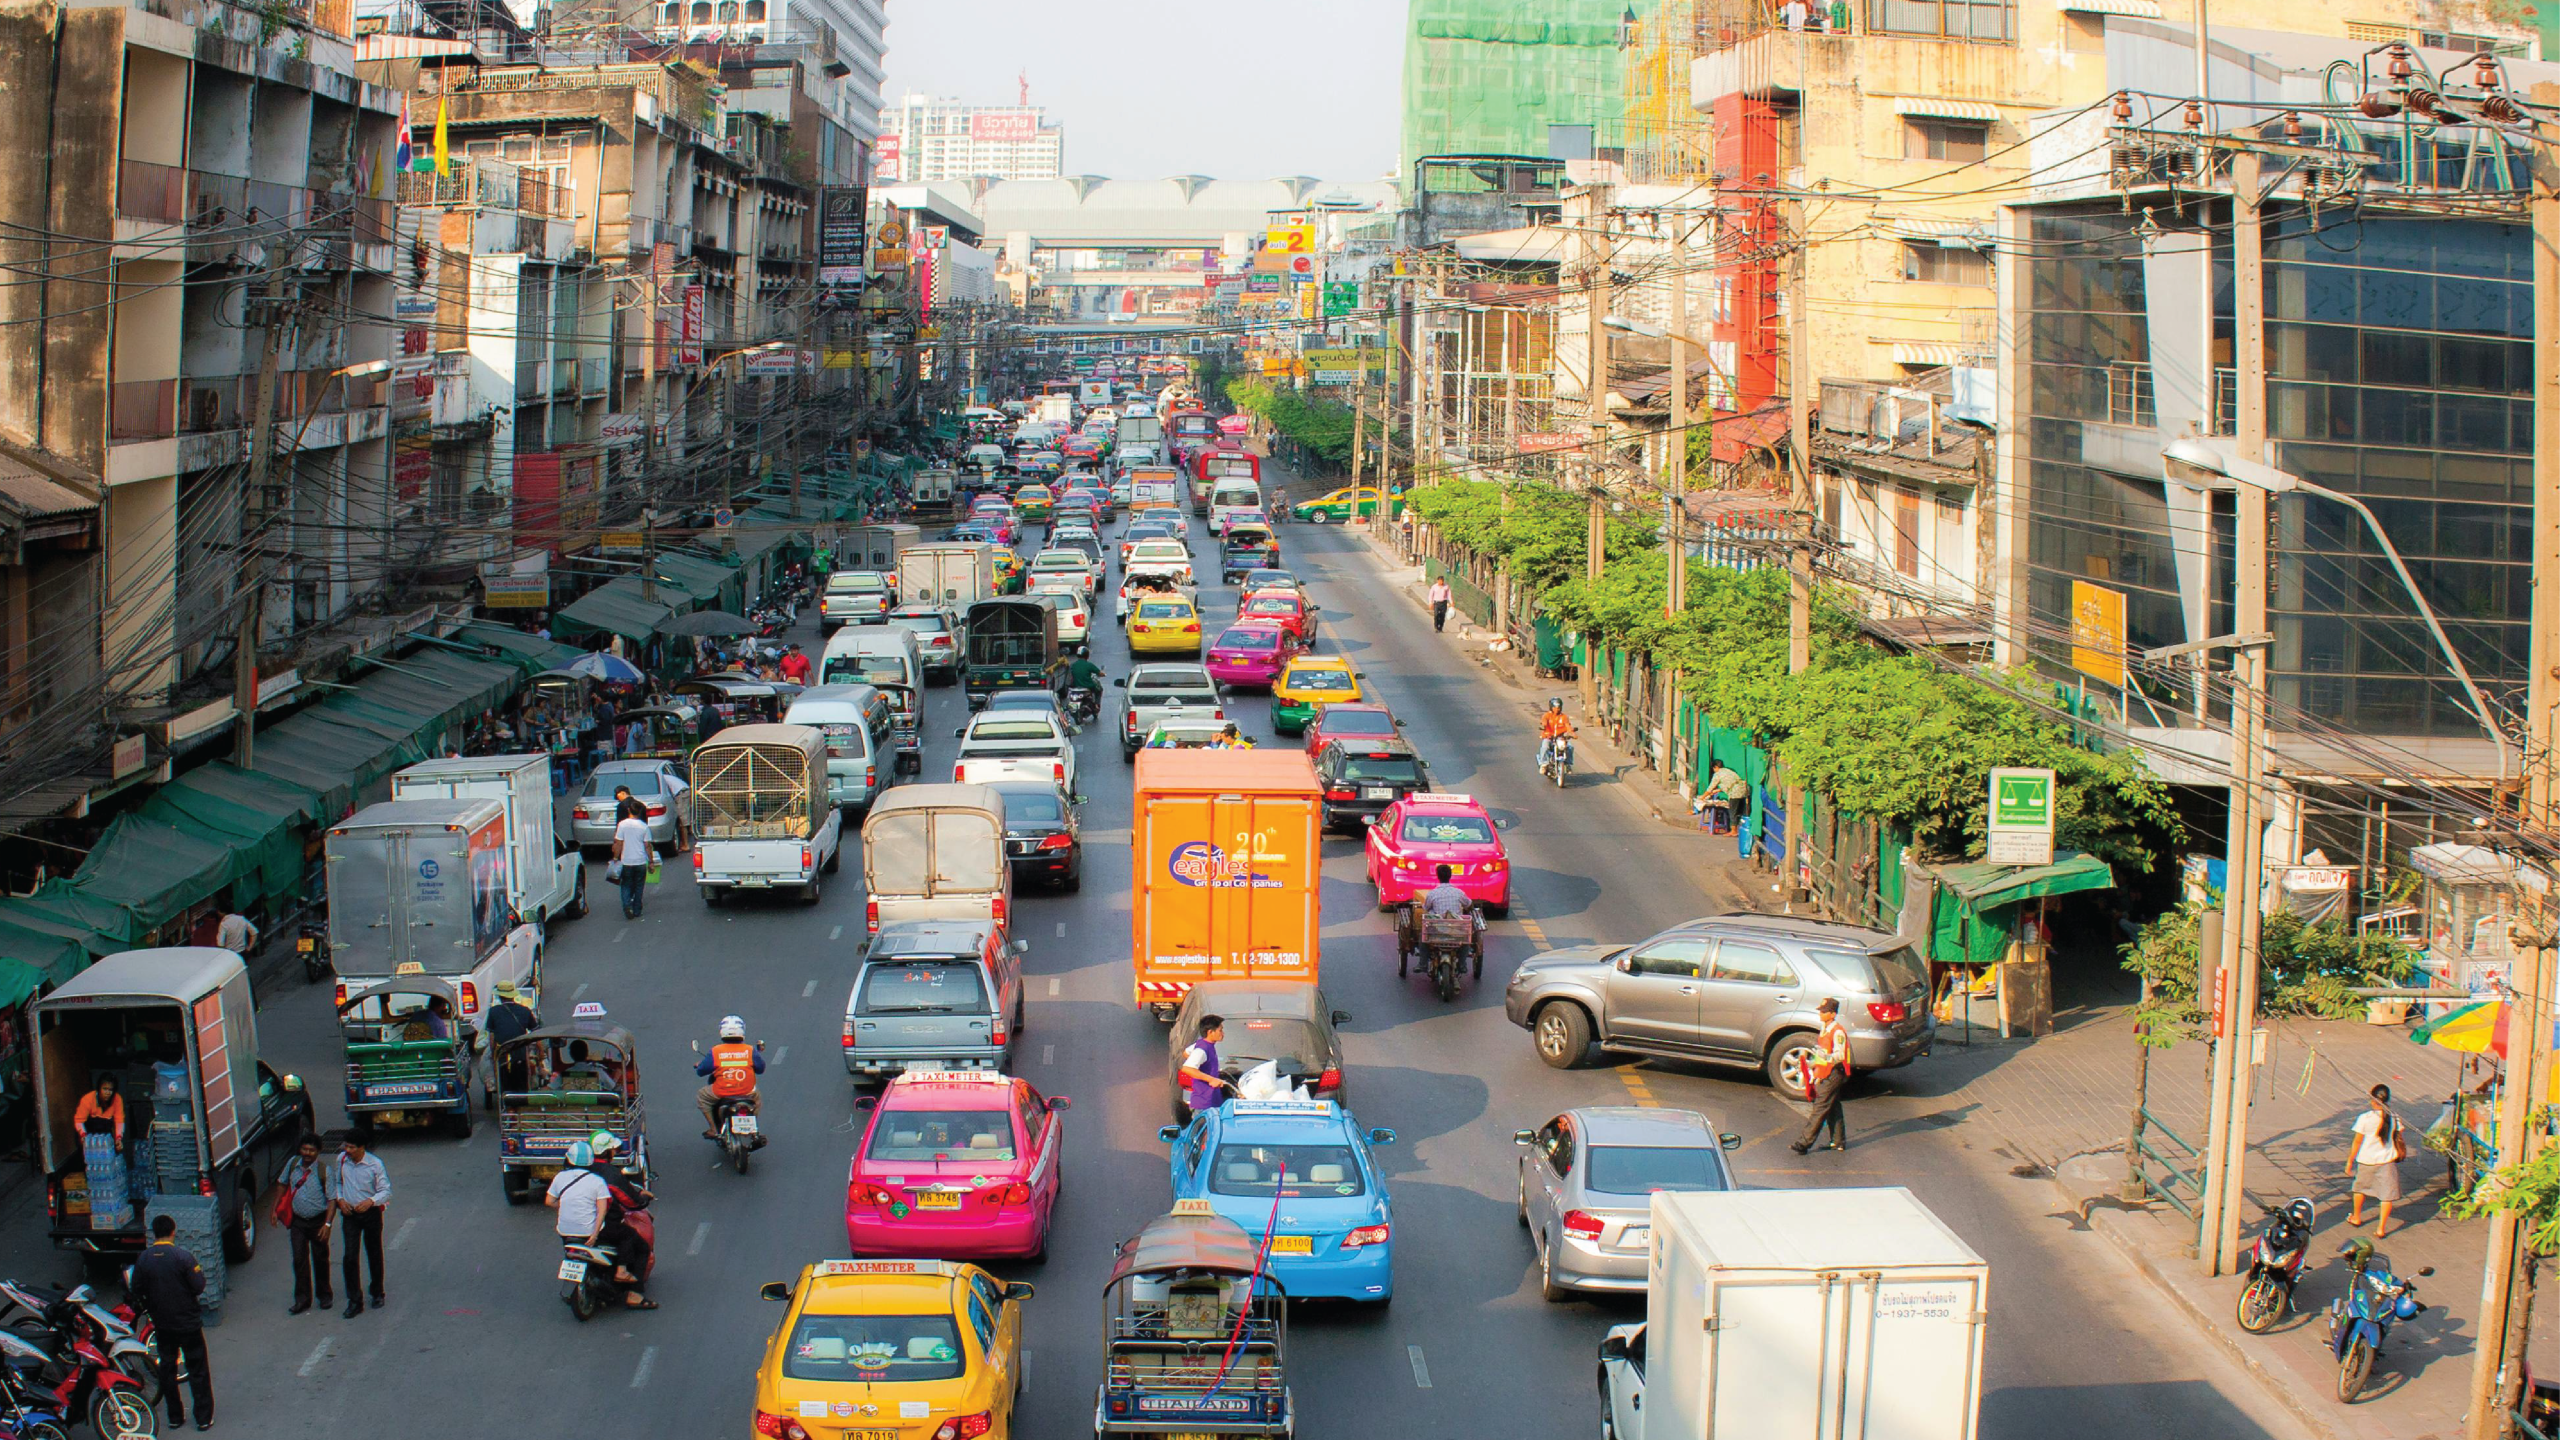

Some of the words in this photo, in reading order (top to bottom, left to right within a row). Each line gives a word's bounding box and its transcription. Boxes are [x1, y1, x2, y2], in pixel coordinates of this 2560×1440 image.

[1287, 231, 1305, 252] 2
[684, 294, 700, 361] Bata
[1174, 854, 1250, 881] eagles
[401, 963, 420, 971] TAXI
[578, 1005, 599, 1013] TAXI
[921, 1073, 982, 1081] TAXI-METER
[935, 1192, 957, 1202] 3748
[1181, 1201, 1208, 1211] TAXI
[1286, 1238, 1310, 1248] 6100
[840, 1263, 915, 1273] TAXI-METER
[1875, 1309, 1949, 1319] 0-1937-5530
[1147, 1400, 1244, 1410] THAILAND
[867, 1431, 894, 1440] 7019
